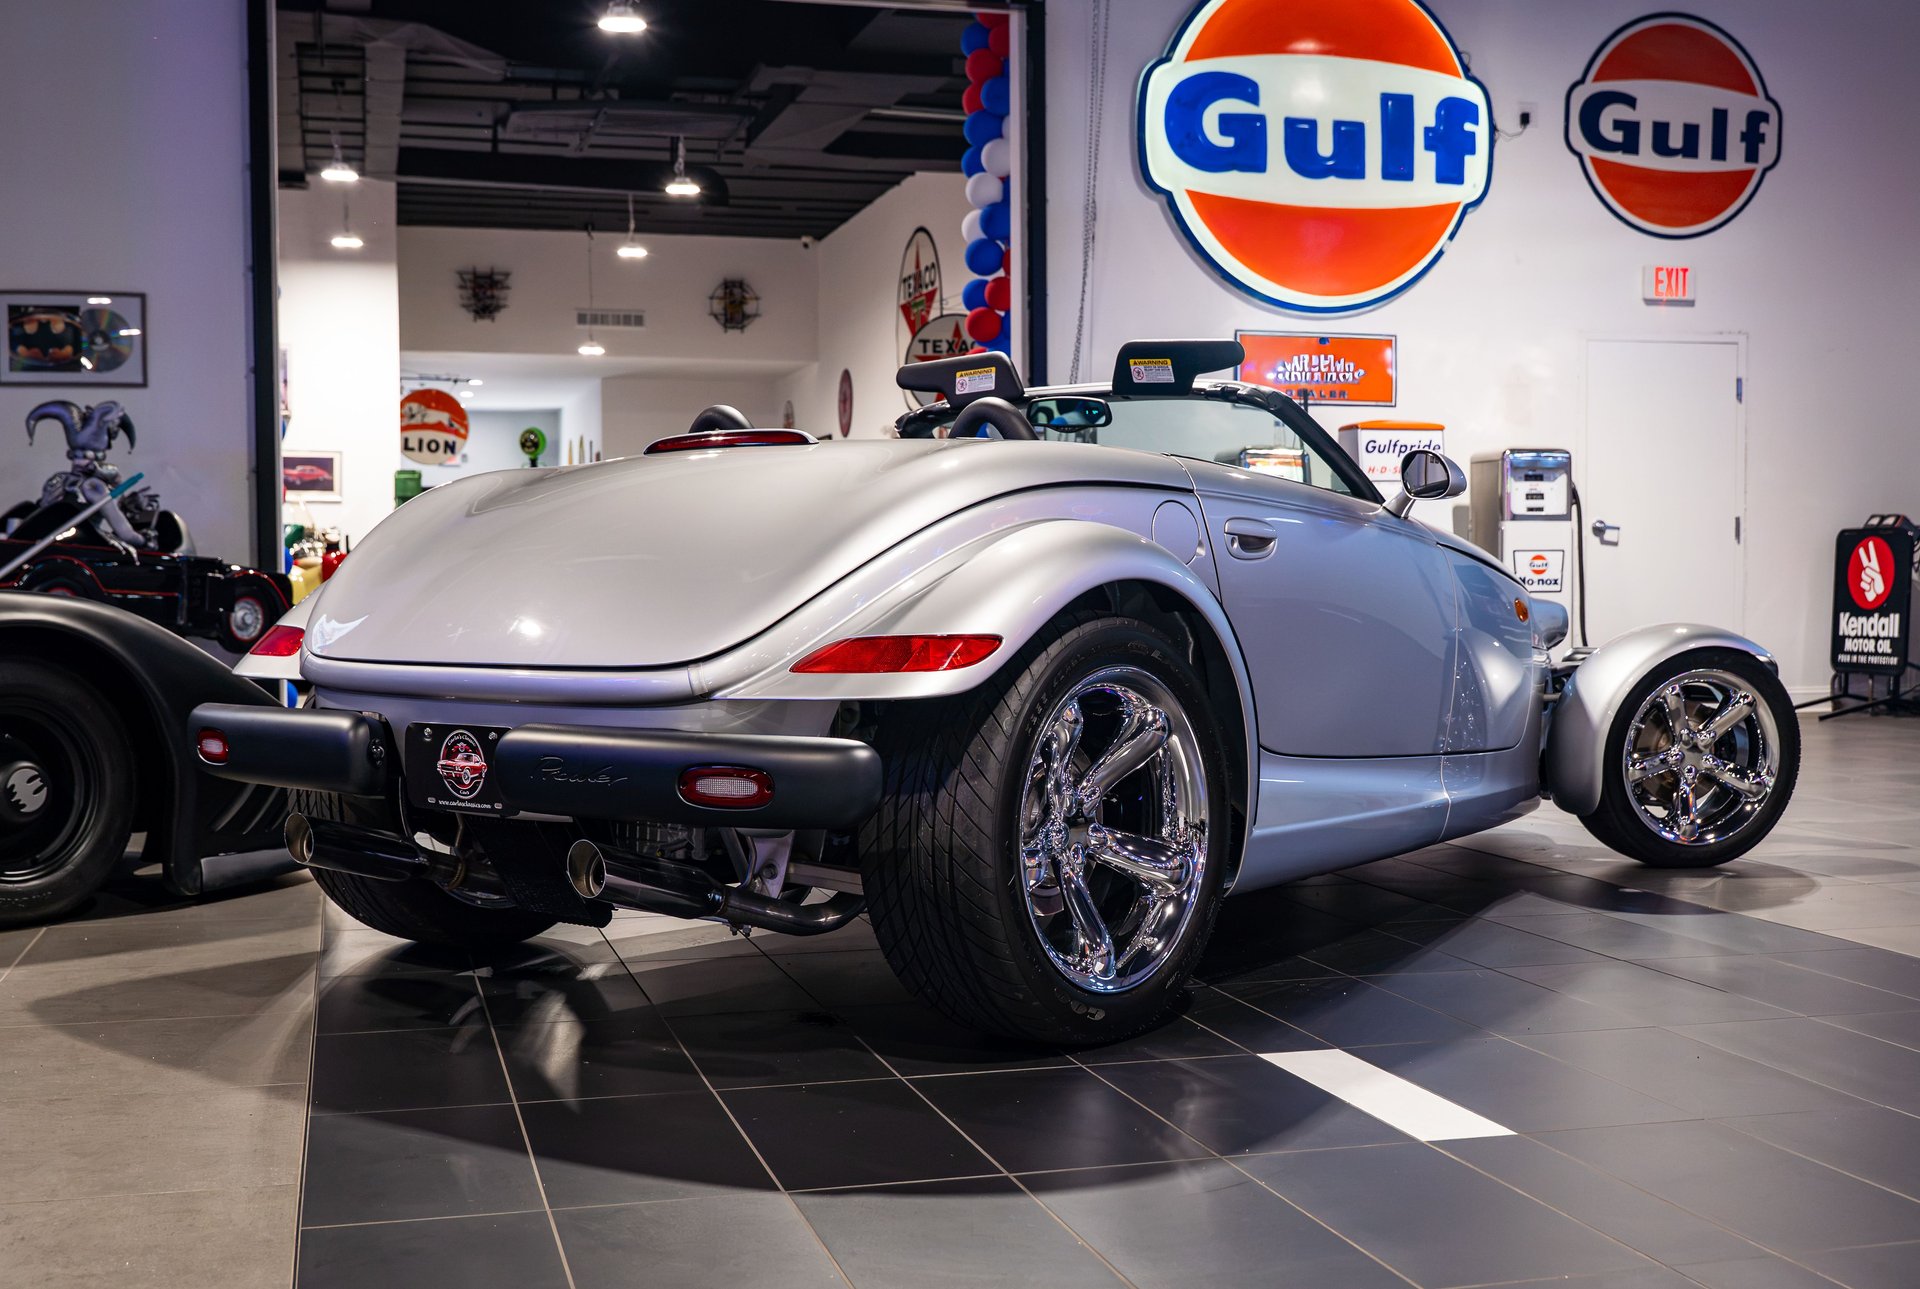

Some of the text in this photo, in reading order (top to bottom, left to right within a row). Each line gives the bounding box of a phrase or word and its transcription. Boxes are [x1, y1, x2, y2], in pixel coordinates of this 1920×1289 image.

[1165, 71, 1479, 185] Gulf
[1579, 91, 1769, 163] Gulf
[903, 261, 936, 300] TEXACO
[1654, 267, 1688, 297] EXIT
[918, 339, 976, 354] TEXA
[963, 369, 993, 377] WARNING
[404, 437, 456, 455] LION
[1839, 612, 1900, 638] Kendall
[1844, 638, 1892, 653] MOTOR OIL
[1858, 655, 1867, 664] THE
